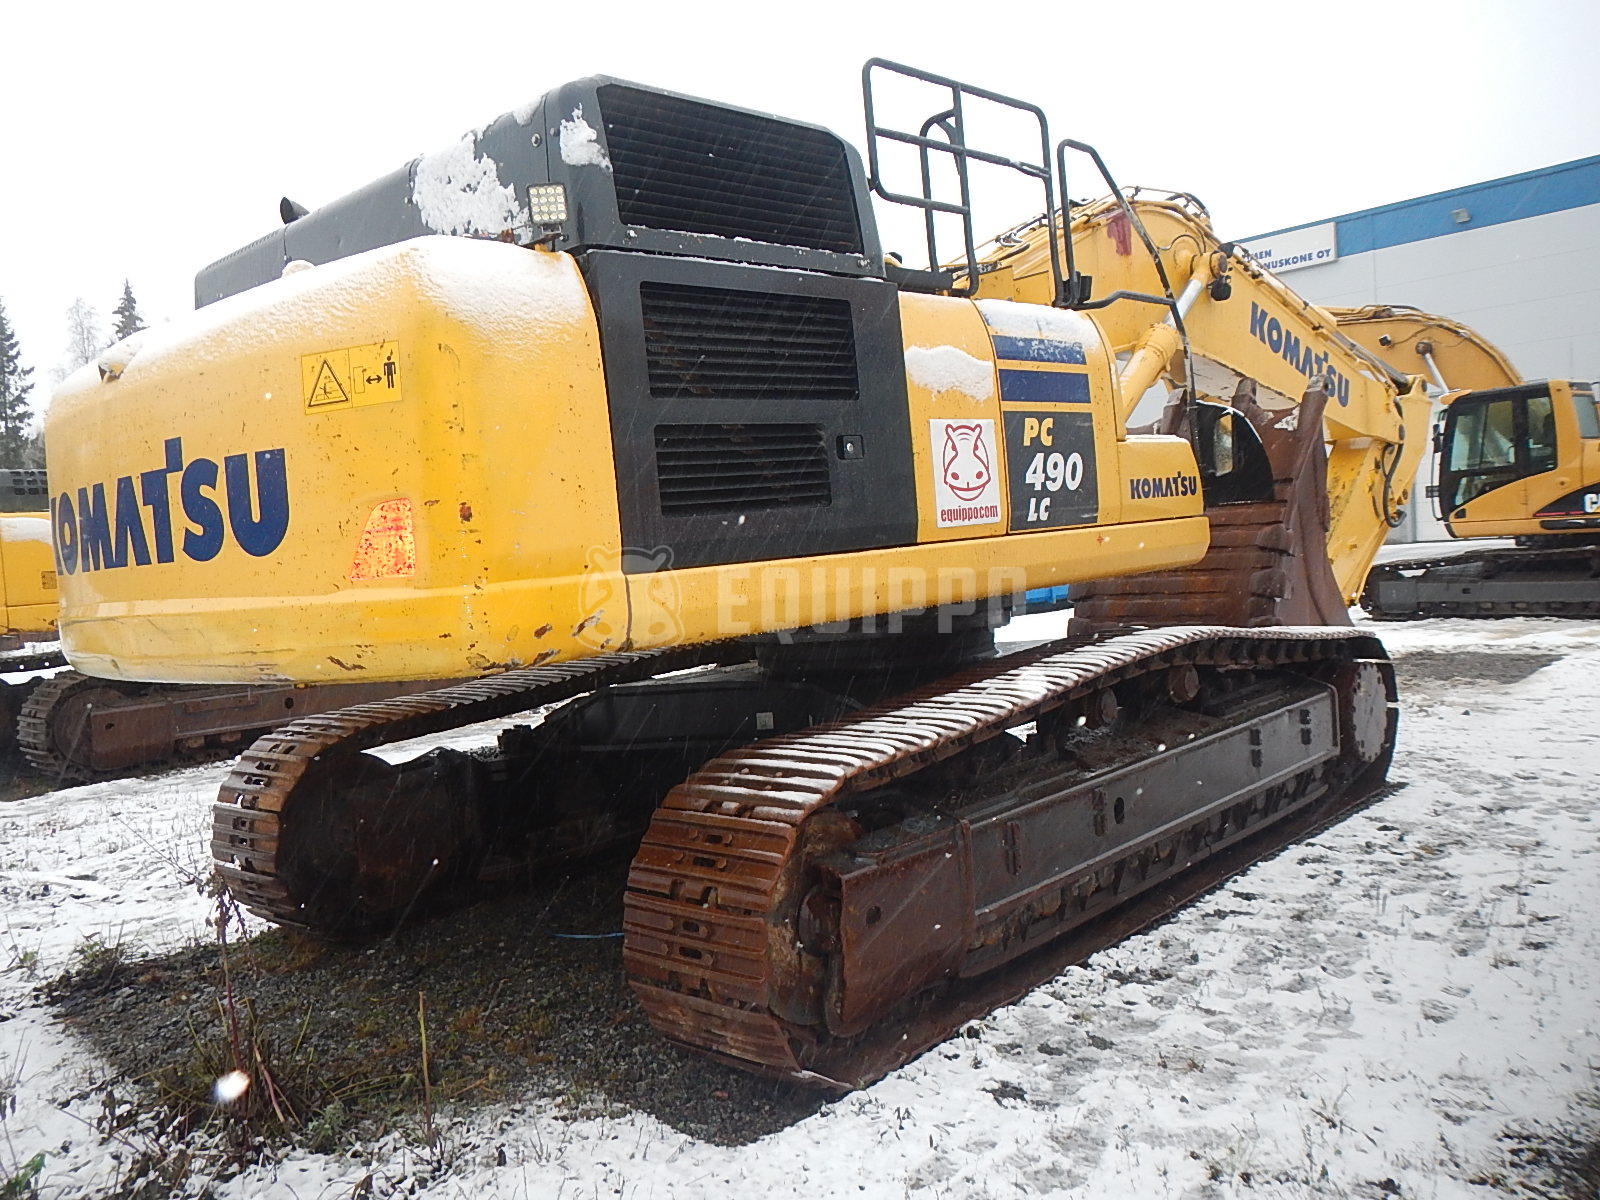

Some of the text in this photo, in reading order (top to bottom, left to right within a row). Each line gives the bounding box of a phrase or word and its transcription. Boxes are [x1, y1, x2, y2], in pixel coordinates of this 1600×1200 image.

[1260, 248, 1331, 269] NUSKONE OY
[1023, 418, 1054, 447] PC
[1025, 452, 1083, 491] 490
[1129, 471, 1197, 499] KOMATSU
[1027, 497, 1051, 522] LC
